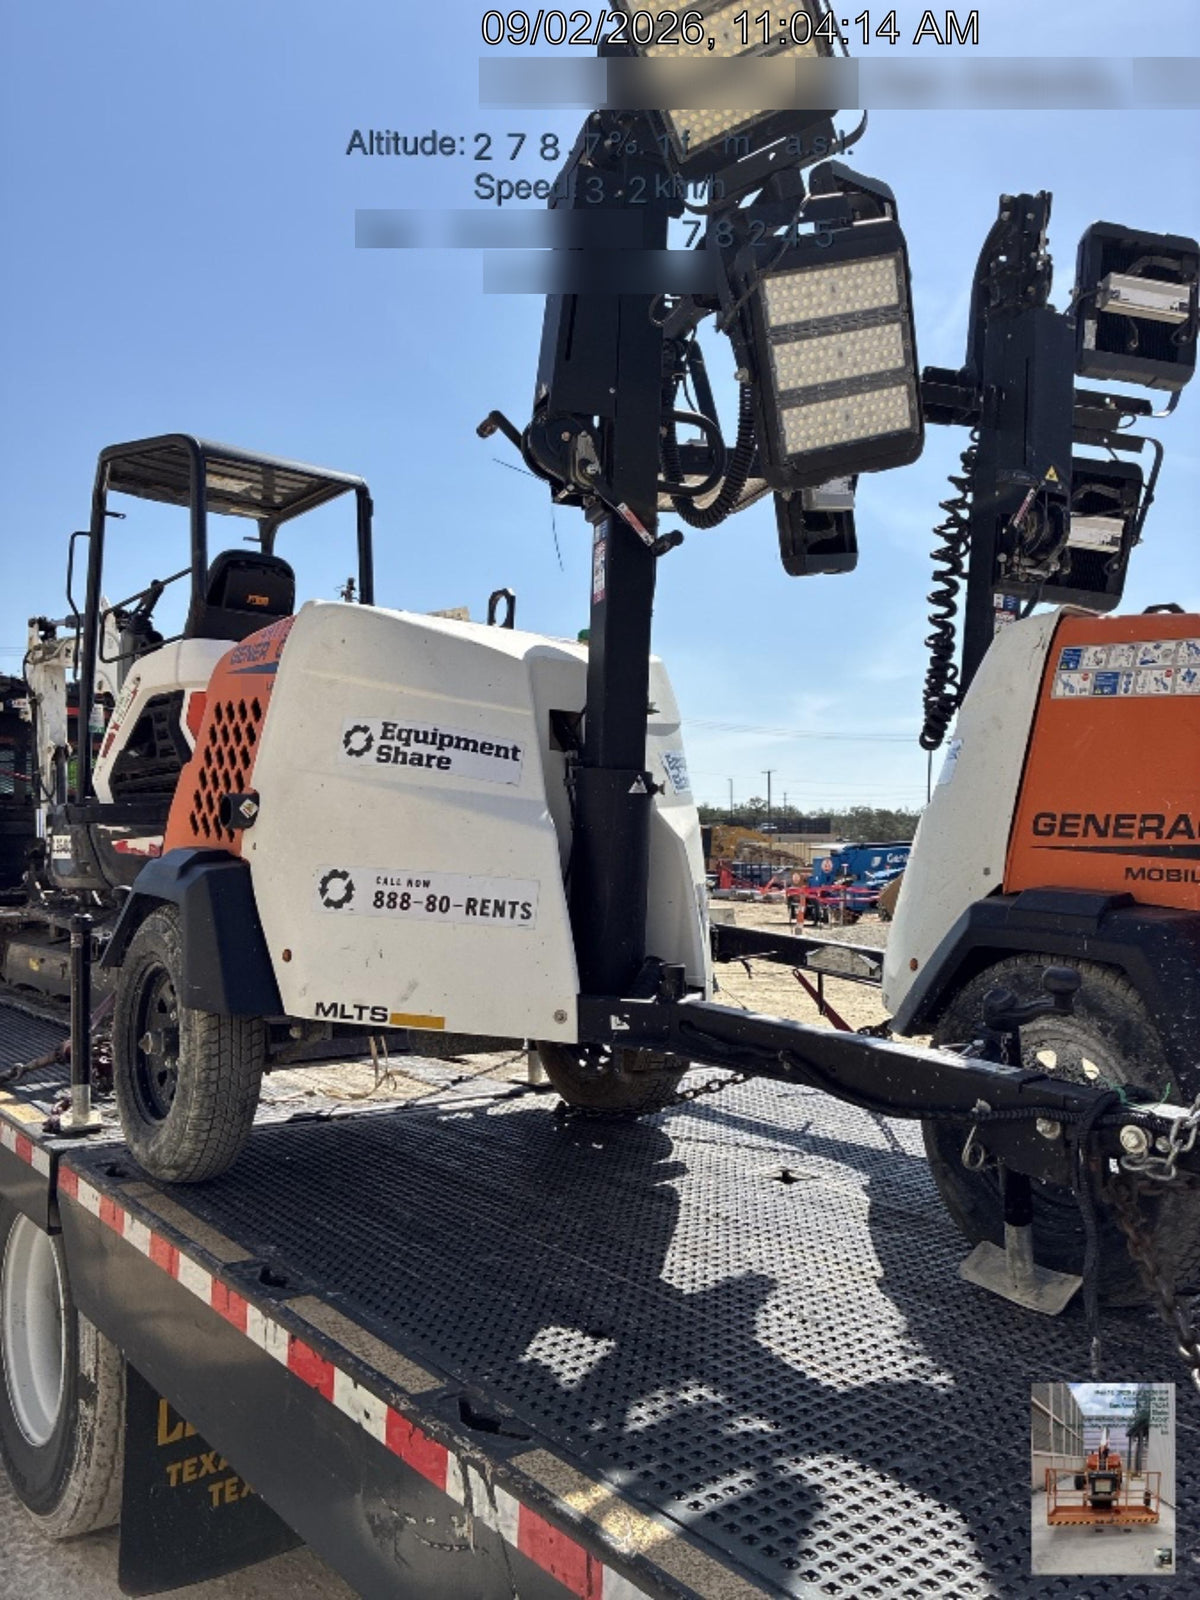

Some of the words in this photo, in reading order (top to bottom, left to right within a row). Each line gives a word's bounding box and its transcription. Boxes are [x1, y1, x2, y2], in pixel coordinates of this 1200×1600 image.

[380, 721, 522, 762] Equipment
[376, 744, 452, 771] Share
[1032, 812, 1200, 840] GENERA
[375, 876, 401, 887] CALL
[406, 878, 432, 888] NOW
[372, 890, 533, 921] 888-80-RENTS
[315, 1002, 389, 1023] MLTS
